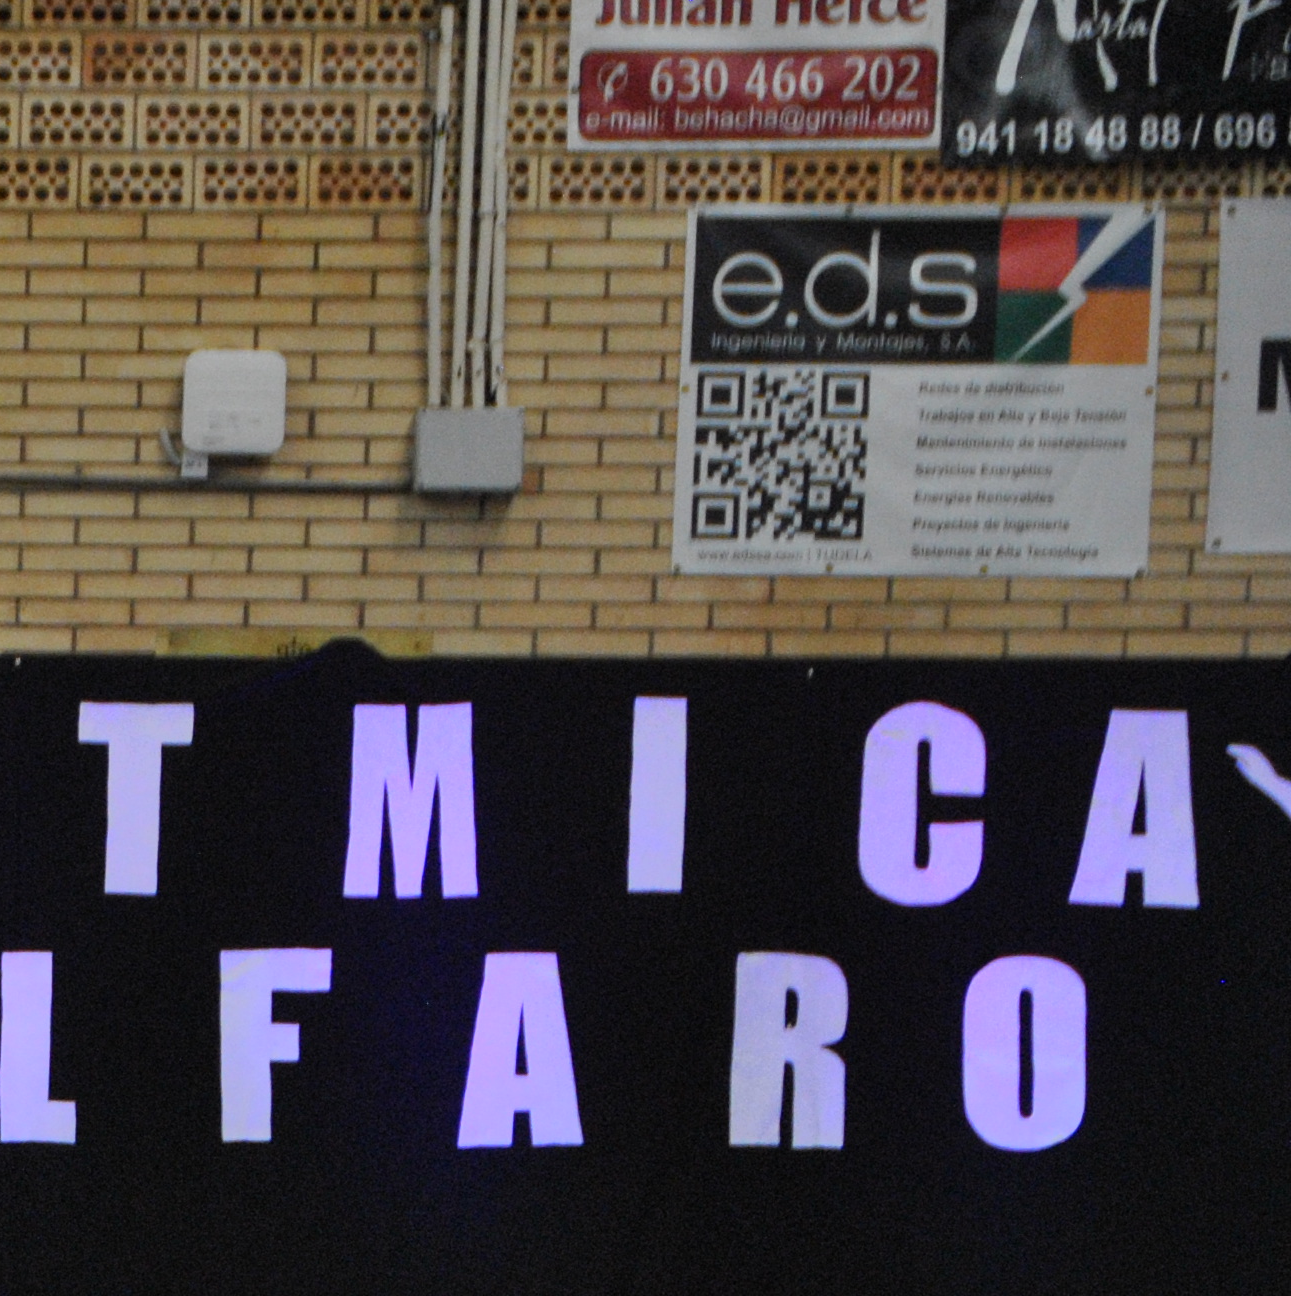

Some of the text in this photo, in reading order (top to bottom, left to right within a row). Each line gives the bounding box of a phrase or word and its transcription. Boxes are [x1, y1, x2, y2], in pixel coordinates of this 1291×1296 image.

[650, 55, 921, 102] 630 466 202
[956, 118, 1017, 158] 941
[1034, 117, 1074, 155] 18
[1084, 114, 1128, 153] 48
[1139, 112, 1182, 151] 88
[712, 228, 979, 329] e.d.s
